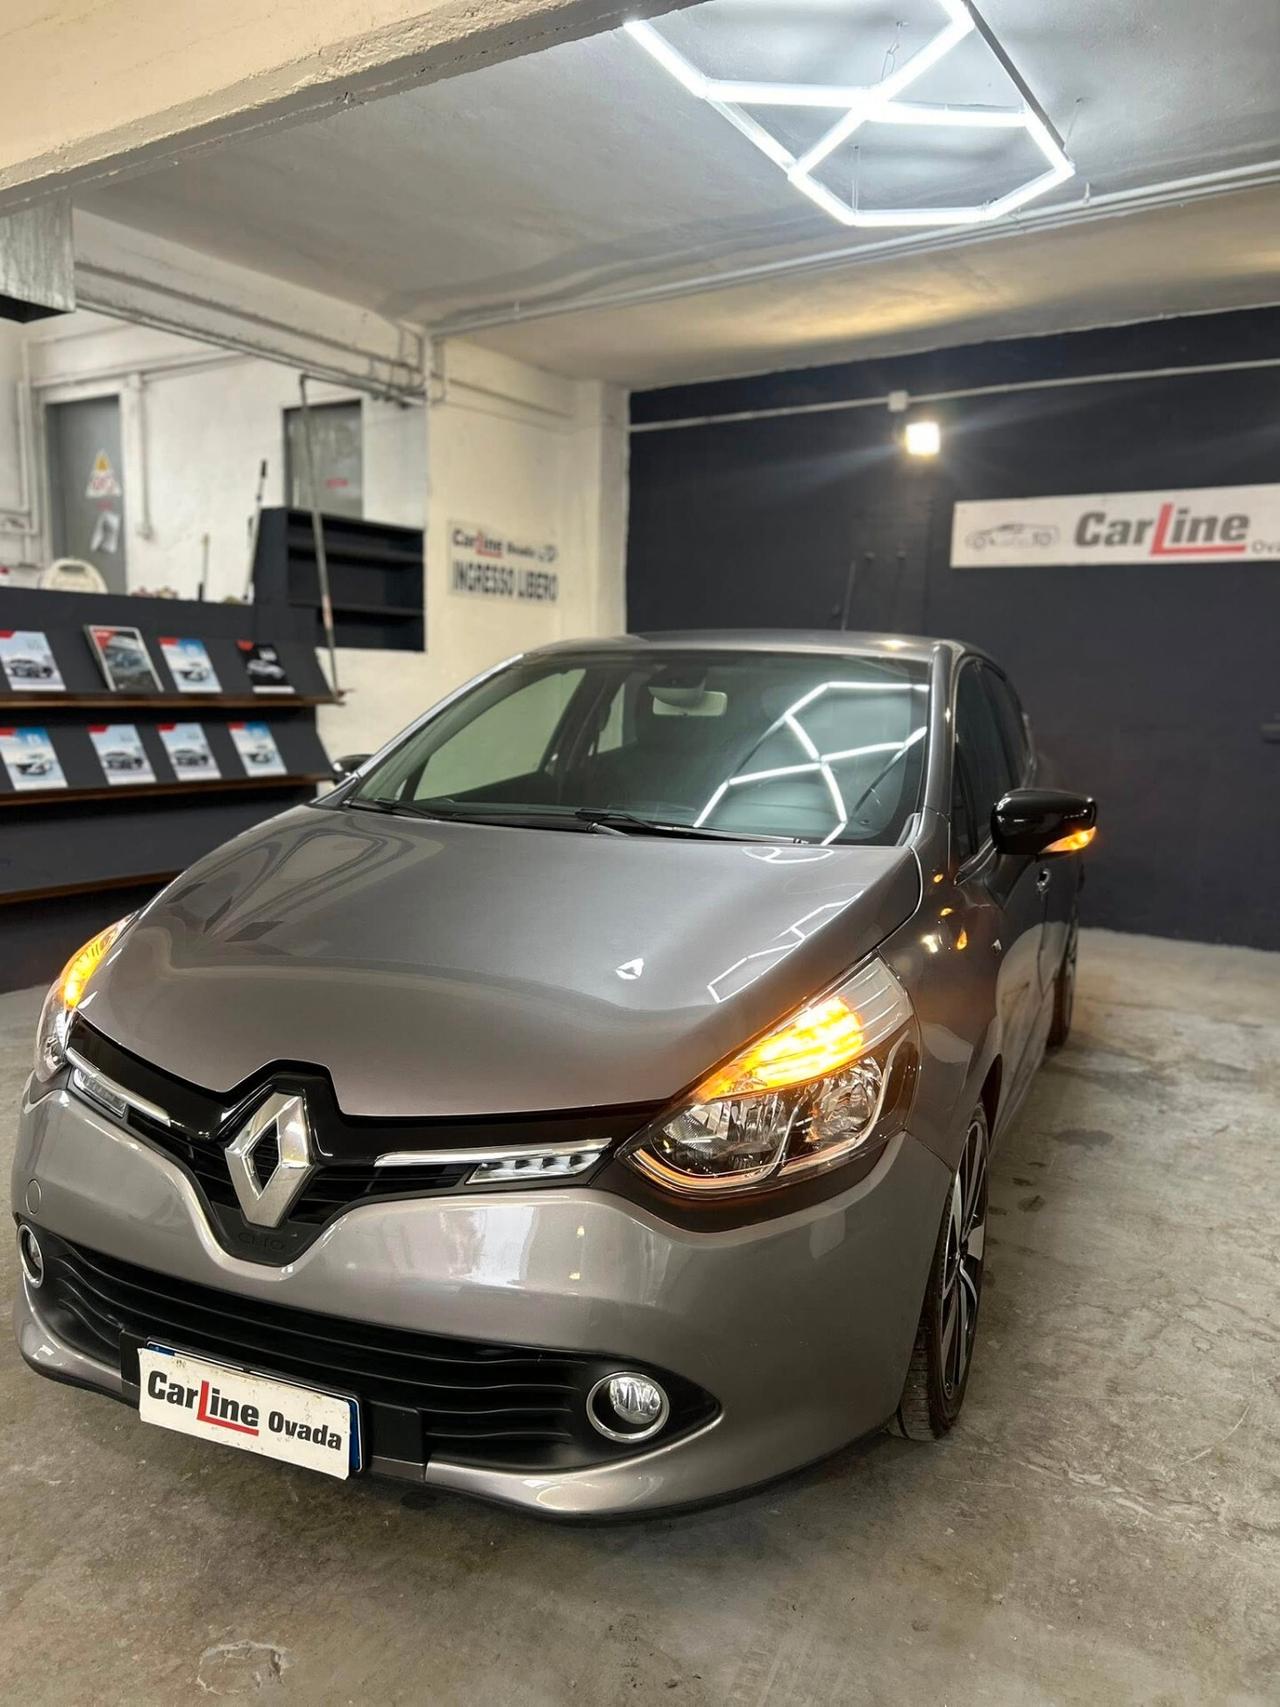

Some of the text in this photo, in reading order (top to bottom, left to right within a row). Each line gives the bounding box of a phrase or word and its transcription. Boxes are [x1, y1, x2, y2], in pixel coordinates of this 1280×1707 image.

[1074, 502, 1250, 556] CarLine
[454, 560, 557, 602] INGRESSO LIBERO
[147, 1370, 342, 1451] CarLine Ovada
